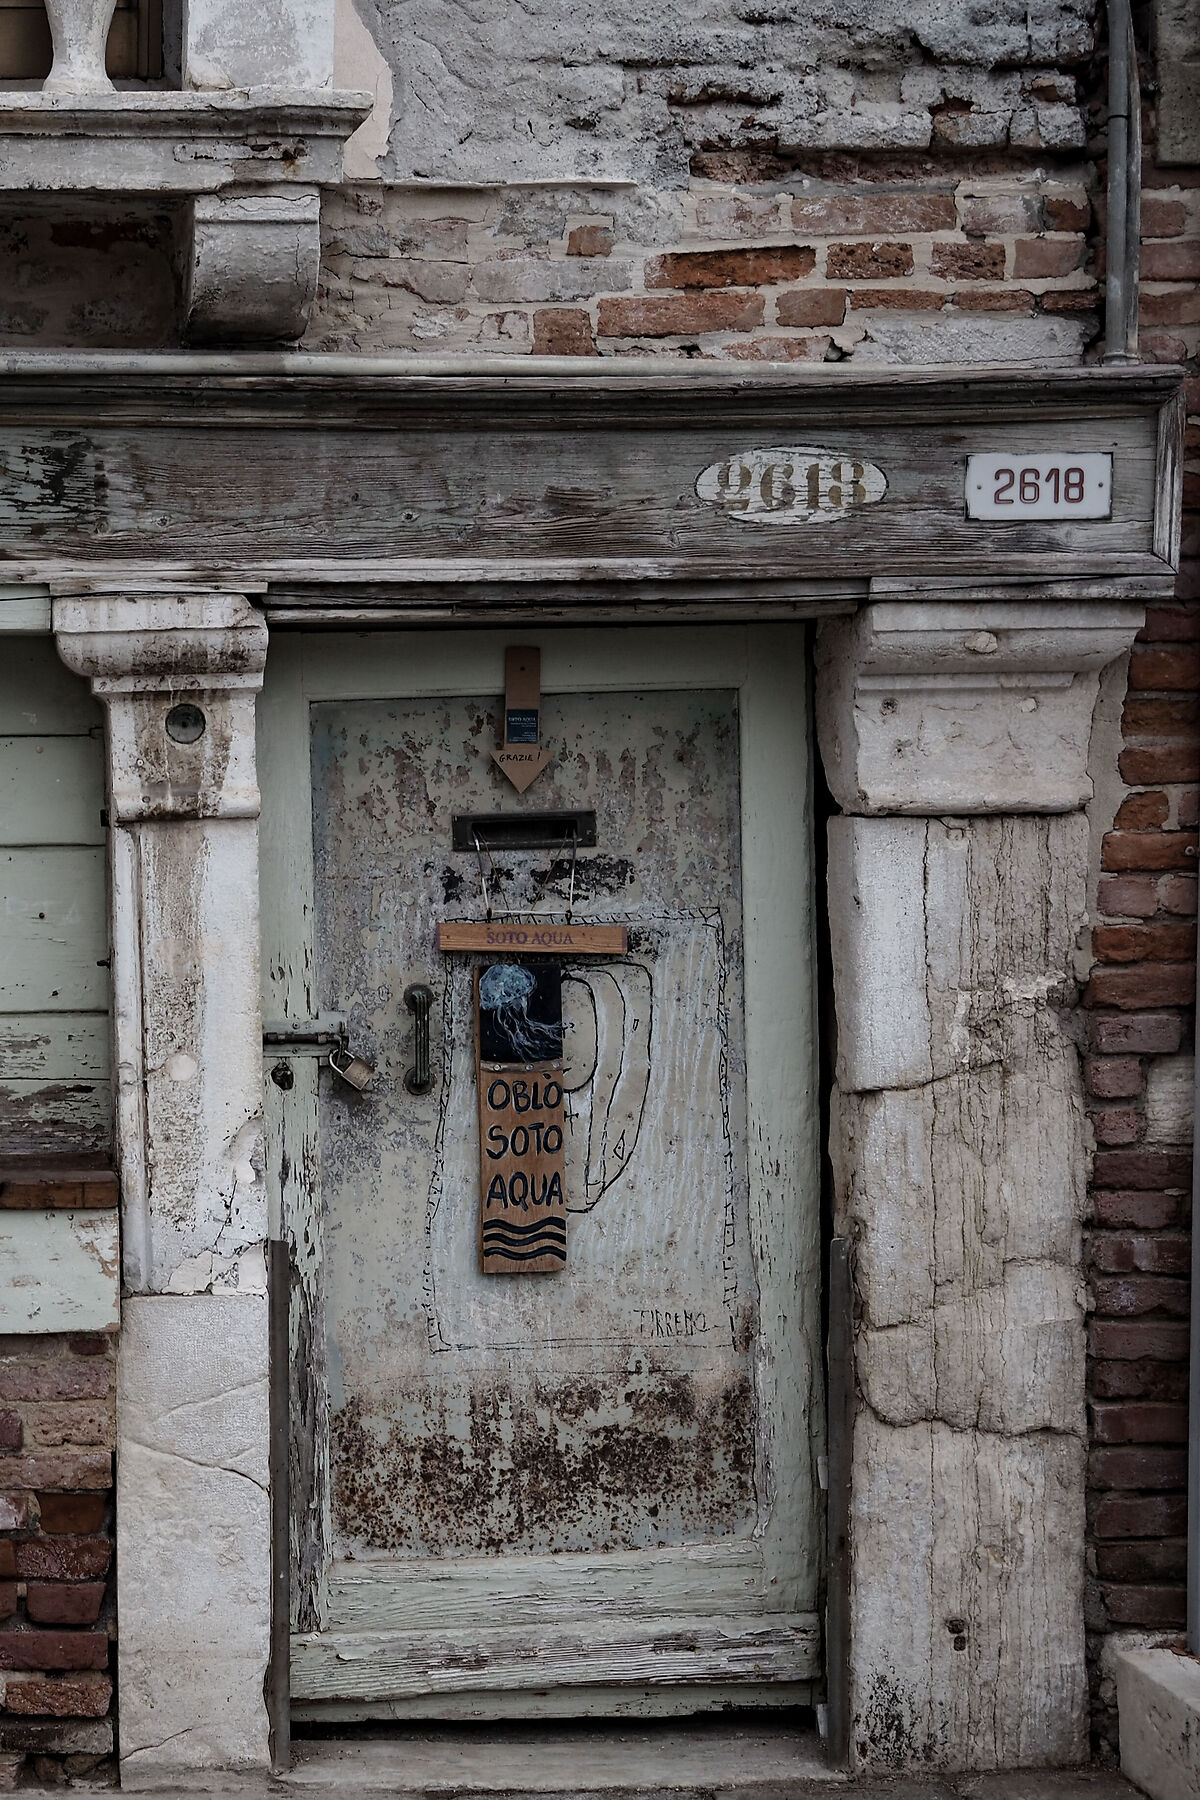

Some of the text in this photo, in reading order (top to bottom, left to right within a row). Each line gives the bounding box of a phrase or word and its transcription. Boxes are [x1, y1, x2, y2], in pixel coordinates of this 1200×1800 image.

[994, 467, 1085, 505] 2618
[487, 931, 574, 947] SOTO AQUA
[487, 1073, 563, 1112] OBLÒ
[486, 1122, 563, 1160] SOTO
[486, 1171, 564, 1212] AQUA
